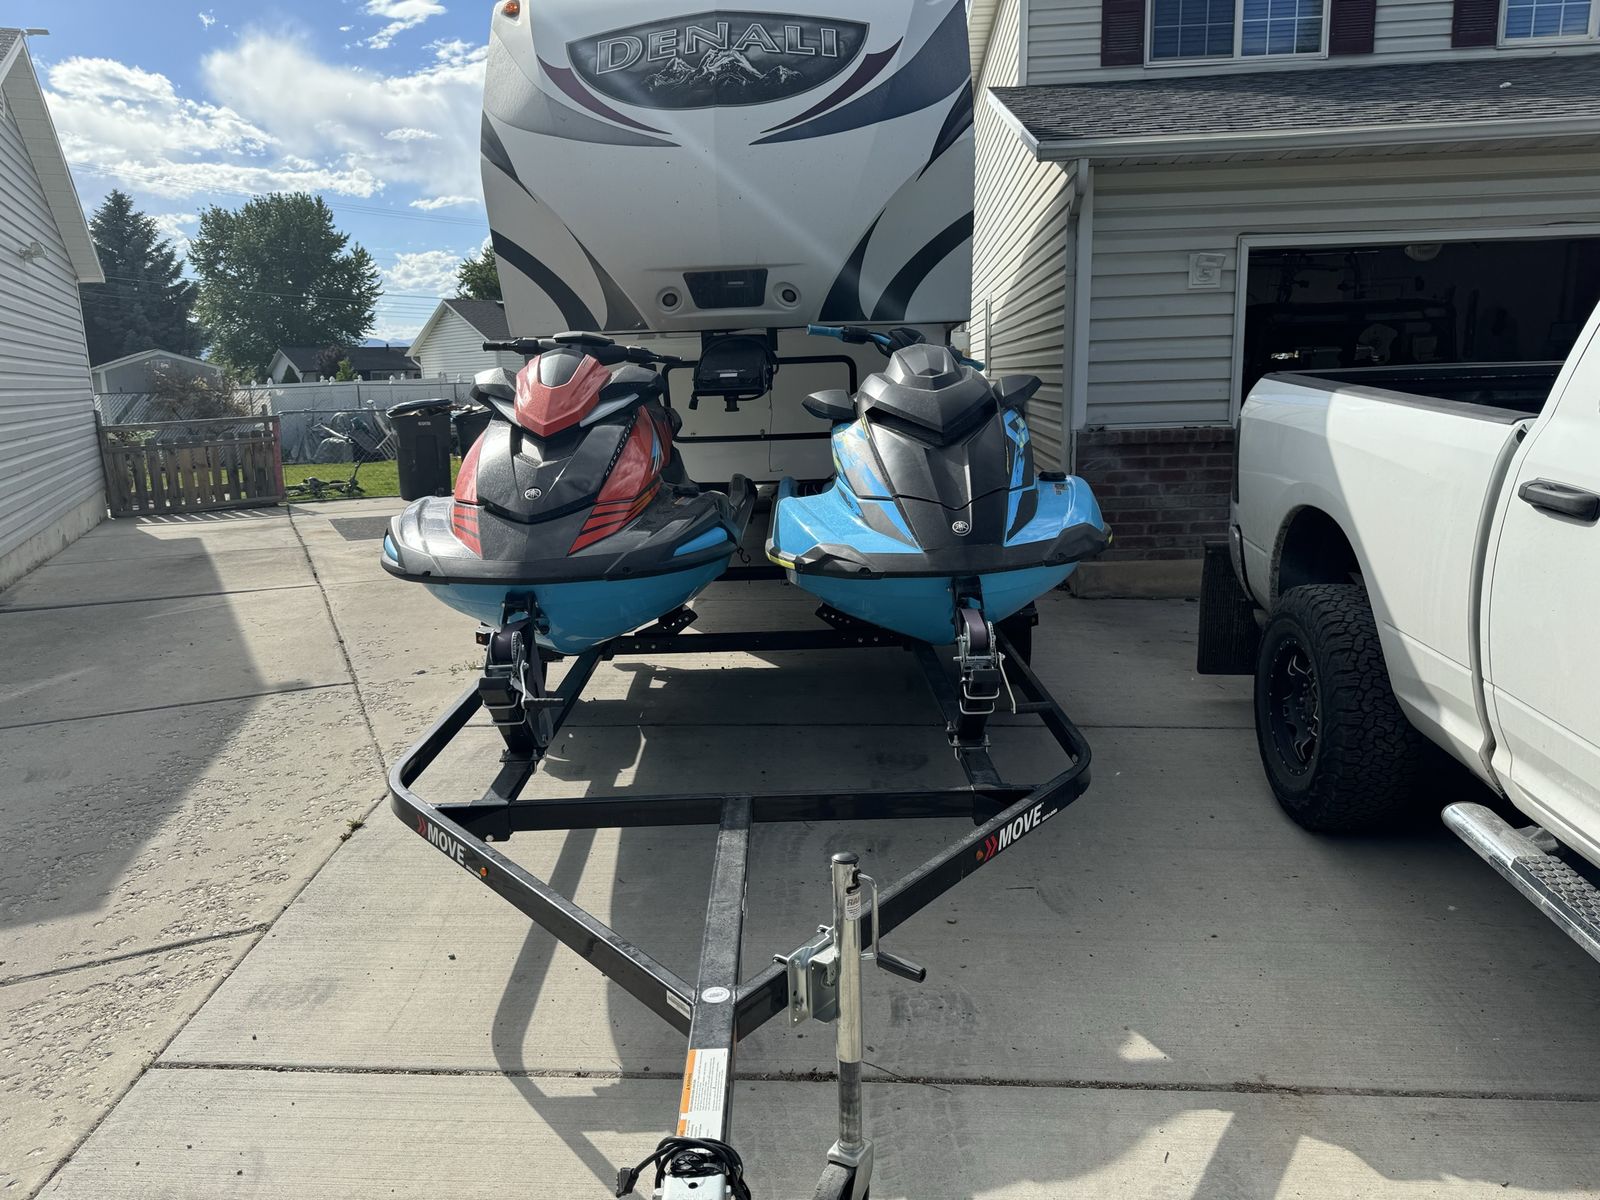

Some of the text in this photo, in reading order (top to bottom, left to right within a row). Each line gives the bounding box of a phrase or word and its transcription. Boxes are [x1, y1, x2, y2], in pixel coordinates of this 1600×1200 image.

[596, 21, 838, 75] DENALI
[427, 822, 465, 866] MOVE
[998, 803, 1042, 852] MOVE
